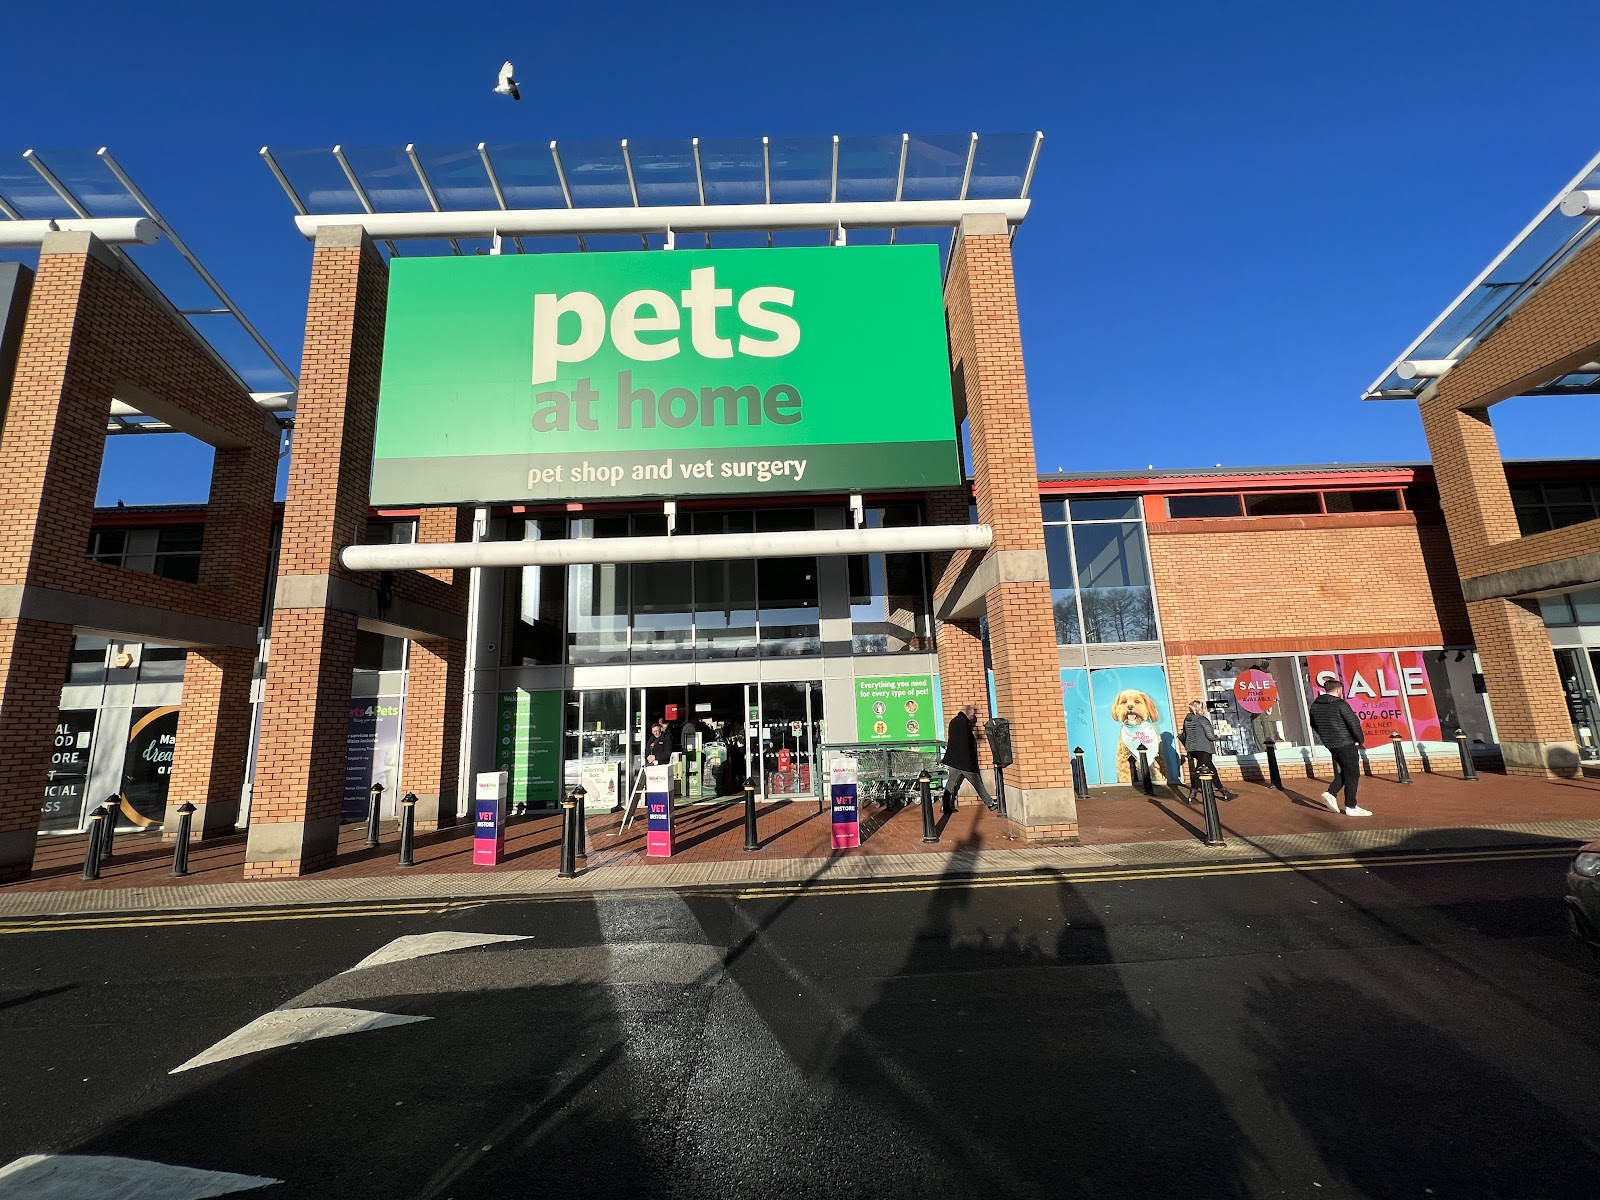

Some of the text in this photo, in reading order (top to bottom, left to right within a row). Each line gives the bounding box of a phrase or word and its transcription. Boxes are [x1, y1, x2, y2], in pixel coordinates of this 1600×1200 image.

[531, 266, 801, 385] pets
[531, 369, 803, 433] at home
[527, 458, 807, 489] pet shop and vet surgery
[860, 679, 927, 689] Everything you need
[1239, 680, 1270, 690] SALE
[872, 690, 890, 698] every
[892, 689, 906, 697] type
[916, 688, 929, 697] pet!
[1354, 709, 1402, 720] 0% OFF
[55, 724, 71, 735] AL
[54, 735, 74, 747] OD
[160, 734, 176, 744] Ma
[51, 752, 79, 764] ORE
[157, 765, 166, 775] a
[835, 796, 853, 805] VET
[651, 805, 665, 813] VET
[479, 811, 493, 820] VET
